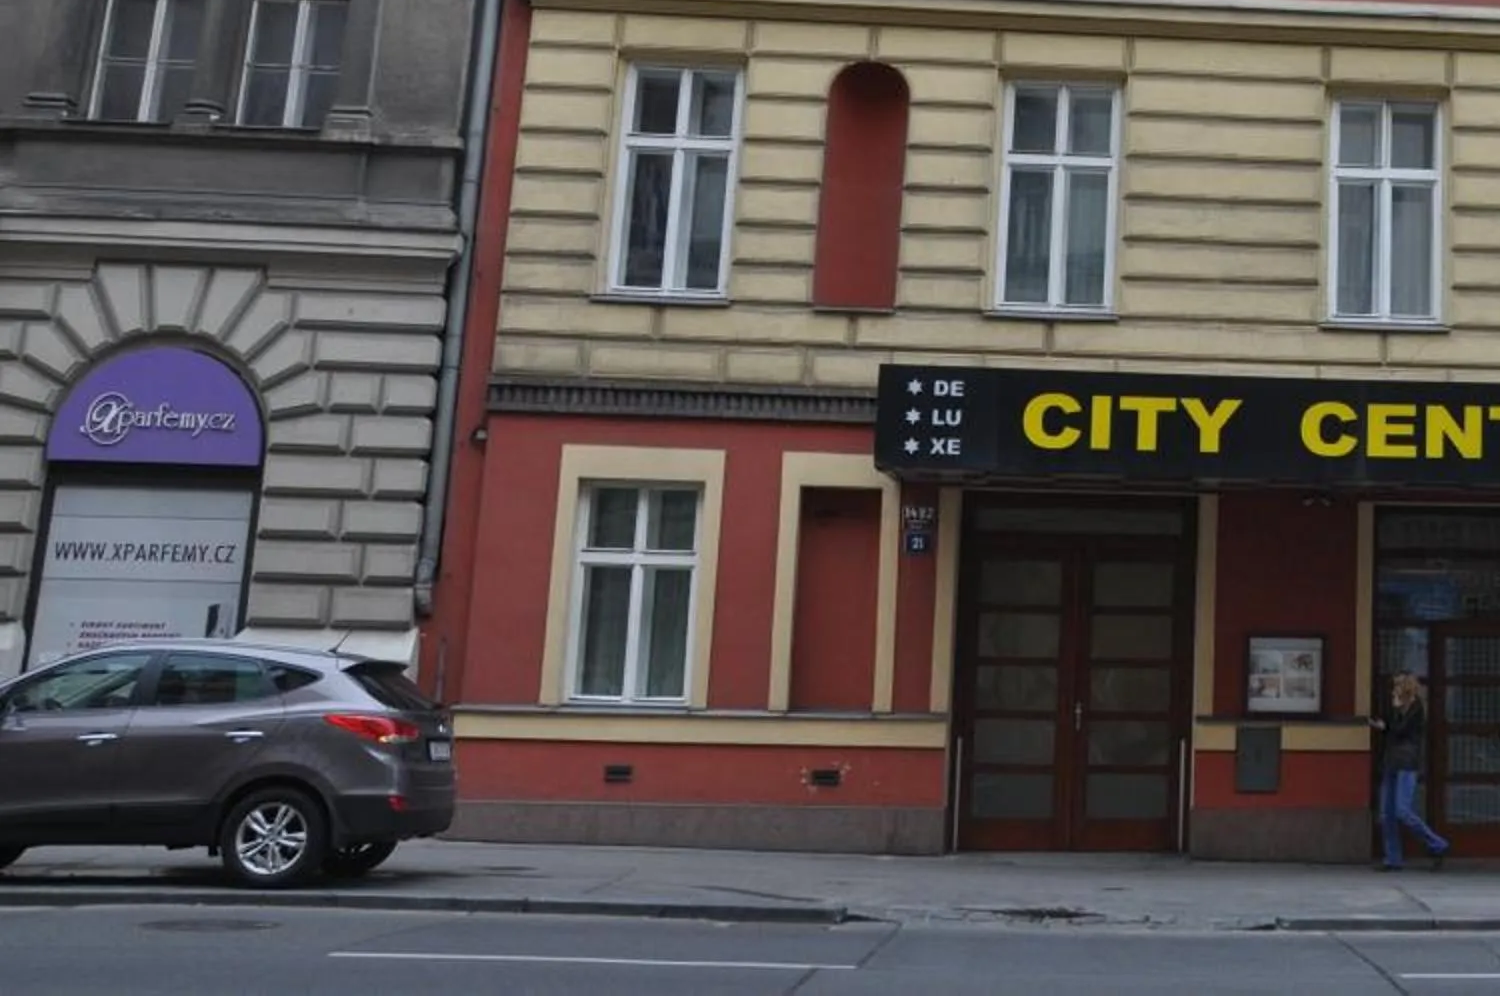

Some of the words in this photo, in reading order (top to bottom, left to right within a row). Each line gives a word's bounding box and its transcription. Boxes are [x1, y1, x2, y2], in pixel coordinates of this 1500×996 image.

[933, 380, 965, 397] DE
[931, 410, 962, 426] LU
[1023, 392, 1243, 453] CITY
[929, 438, 962, 455] XE
[54, 541, 237, 564] WWW.XPARFEMY.CZ
